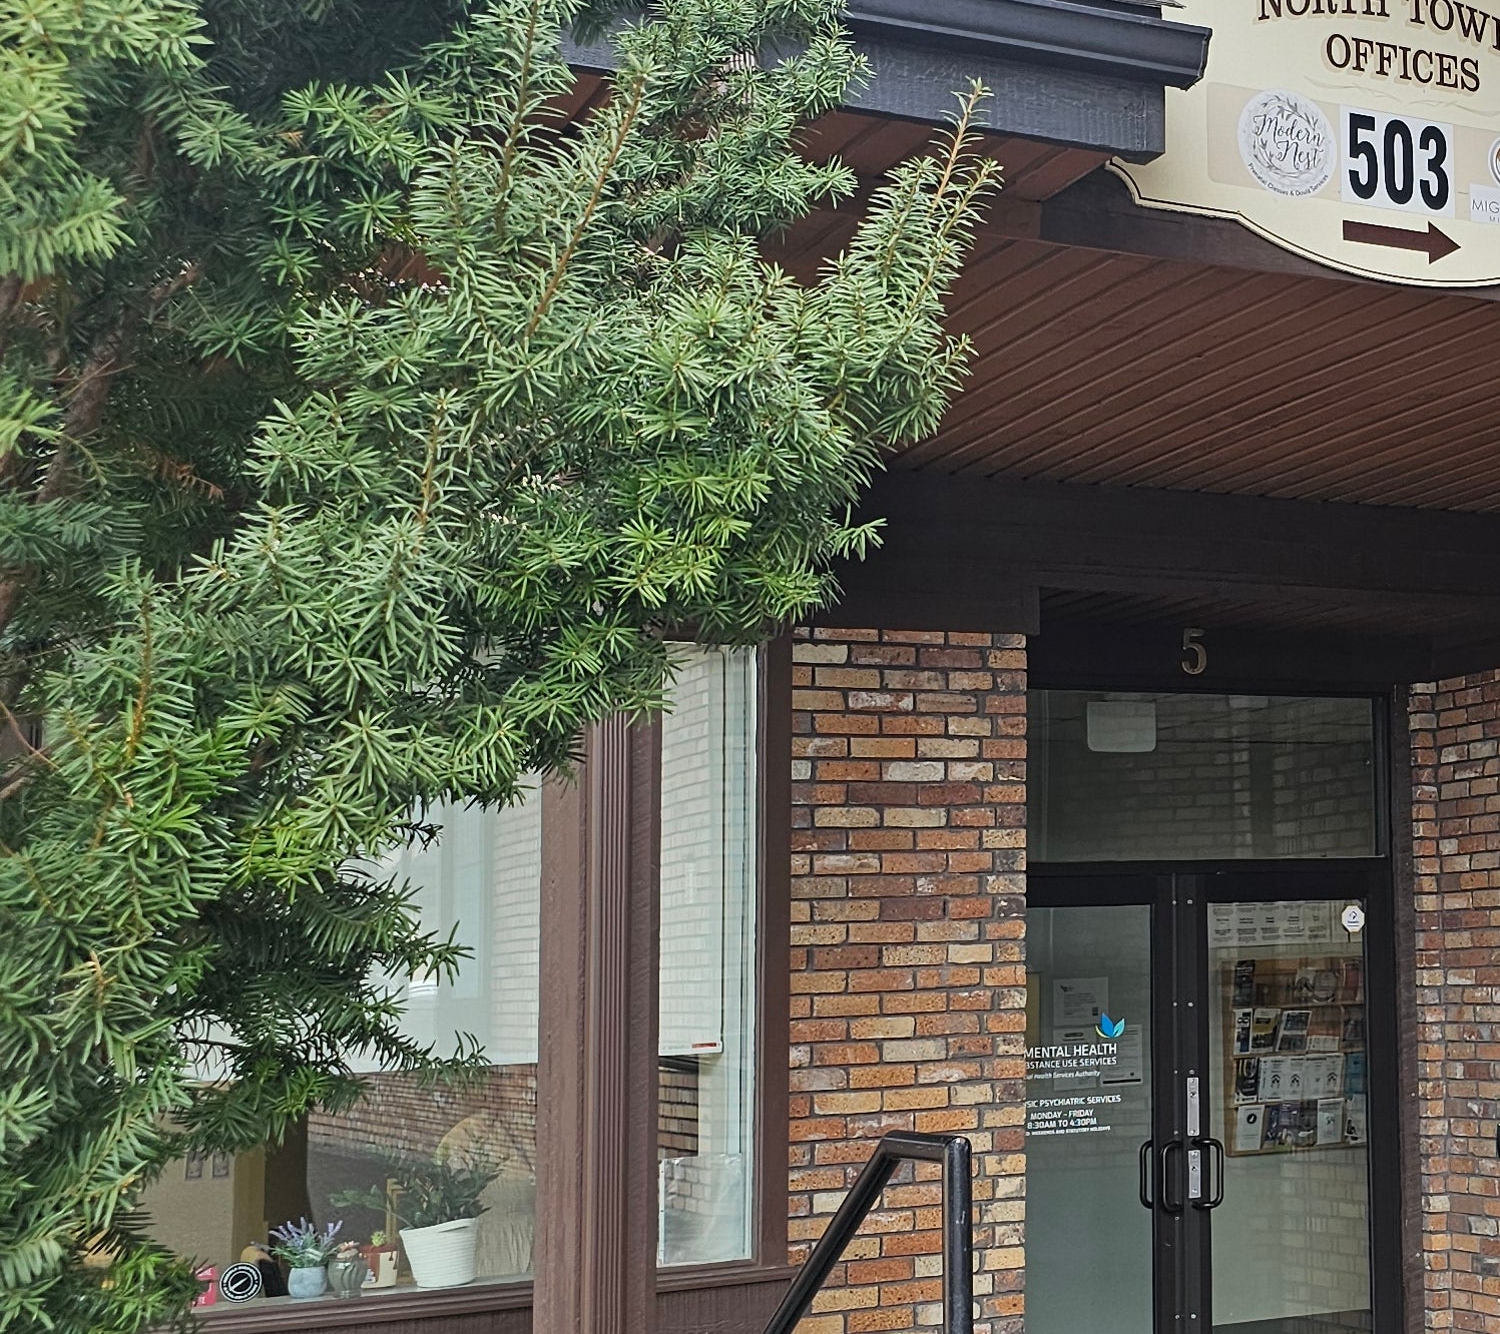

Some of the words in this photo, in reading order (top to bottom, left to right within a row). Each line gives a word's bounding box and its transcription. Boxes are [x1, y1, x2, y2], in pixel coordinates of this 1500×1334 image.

[1326, 33, 1481, 93] OFFICES
[1253, 114, 1326, 148] Modern
[1277, 140, 1325, 171] Nest
[1348, 113, 1450, 211] 503
[1181, 628, 1208, 675] 5
[1024, 1045, 1072, 1059] MENTAL
[1073, 1043, 1117, 1057] HEALTH
[1026, 1059, 1061, 1070] BSTANCE
[1062, 1058, 1078, 1068] USE
[1079, 1057, 1117, 1067] SERVICES
[1040, 1097, 1086, 1107] PSYCHIATRIC
[1086, 1094, 1121, 1104] SERVICES
[1027, 1120, 1057, 1130] 8:30AM
[1058, 1119, 1068, 1128] TO
[1069, 1117, 1098, 1127] 4:30PM
[1030, 1110, 1062, 1120] MONDAY
[1068, 1108, 1094, 1118] FRIDAY
